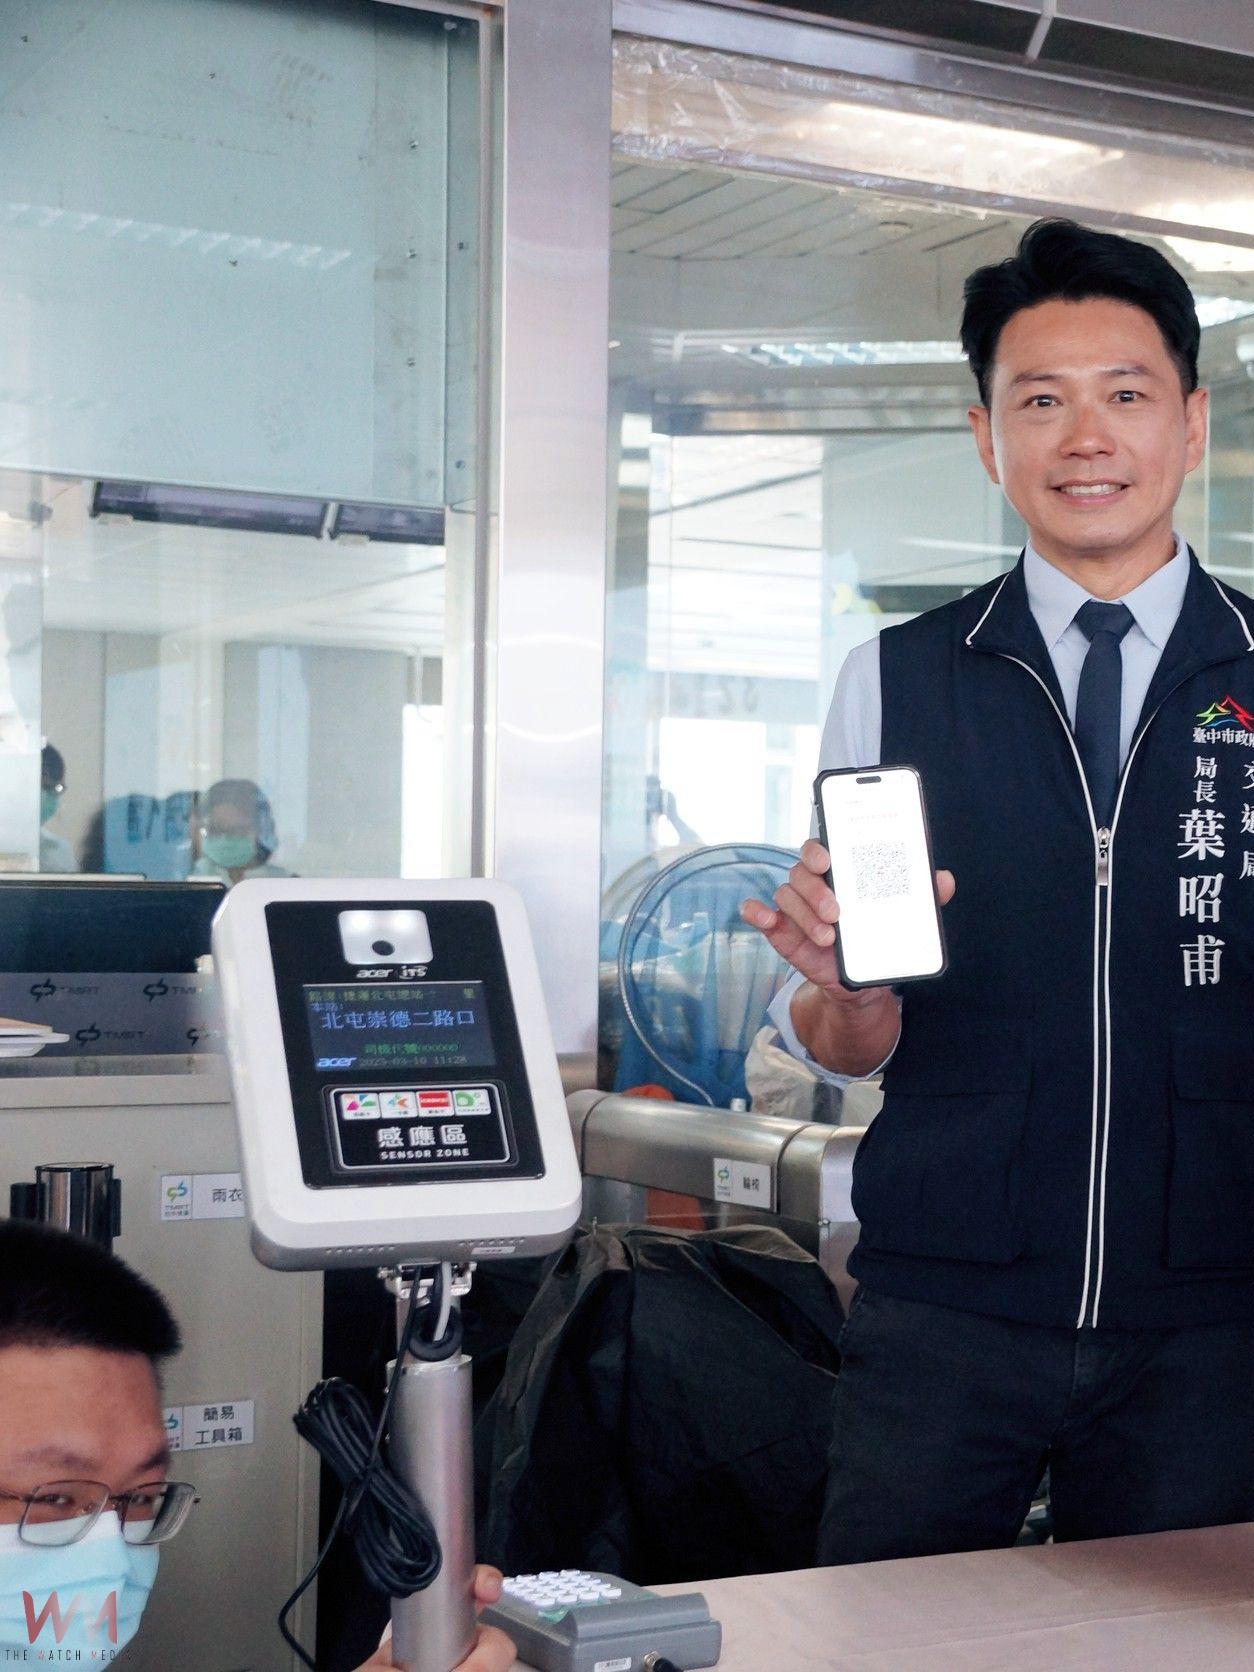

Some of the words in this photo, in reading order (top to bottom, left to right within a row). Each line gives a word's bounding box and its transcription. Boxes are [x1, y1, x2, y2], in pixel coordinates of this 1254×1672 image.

[356, 969, 393, 978] acer
[322, 1010, 475, 1029] 北屯崇德二路口
[316, 1057, 357, 1068] acer
[377, 1124, 468, 1148] 感應區
[380, 1149, 432, 1160] SENSOR
[437, 1148, 470, 1158] ZONE
[212, 1188, 243, 1203] 雨衣
[204, 1405, 235, 1422] 簡易
[195, 1427, 243, 1445] 工具箱
